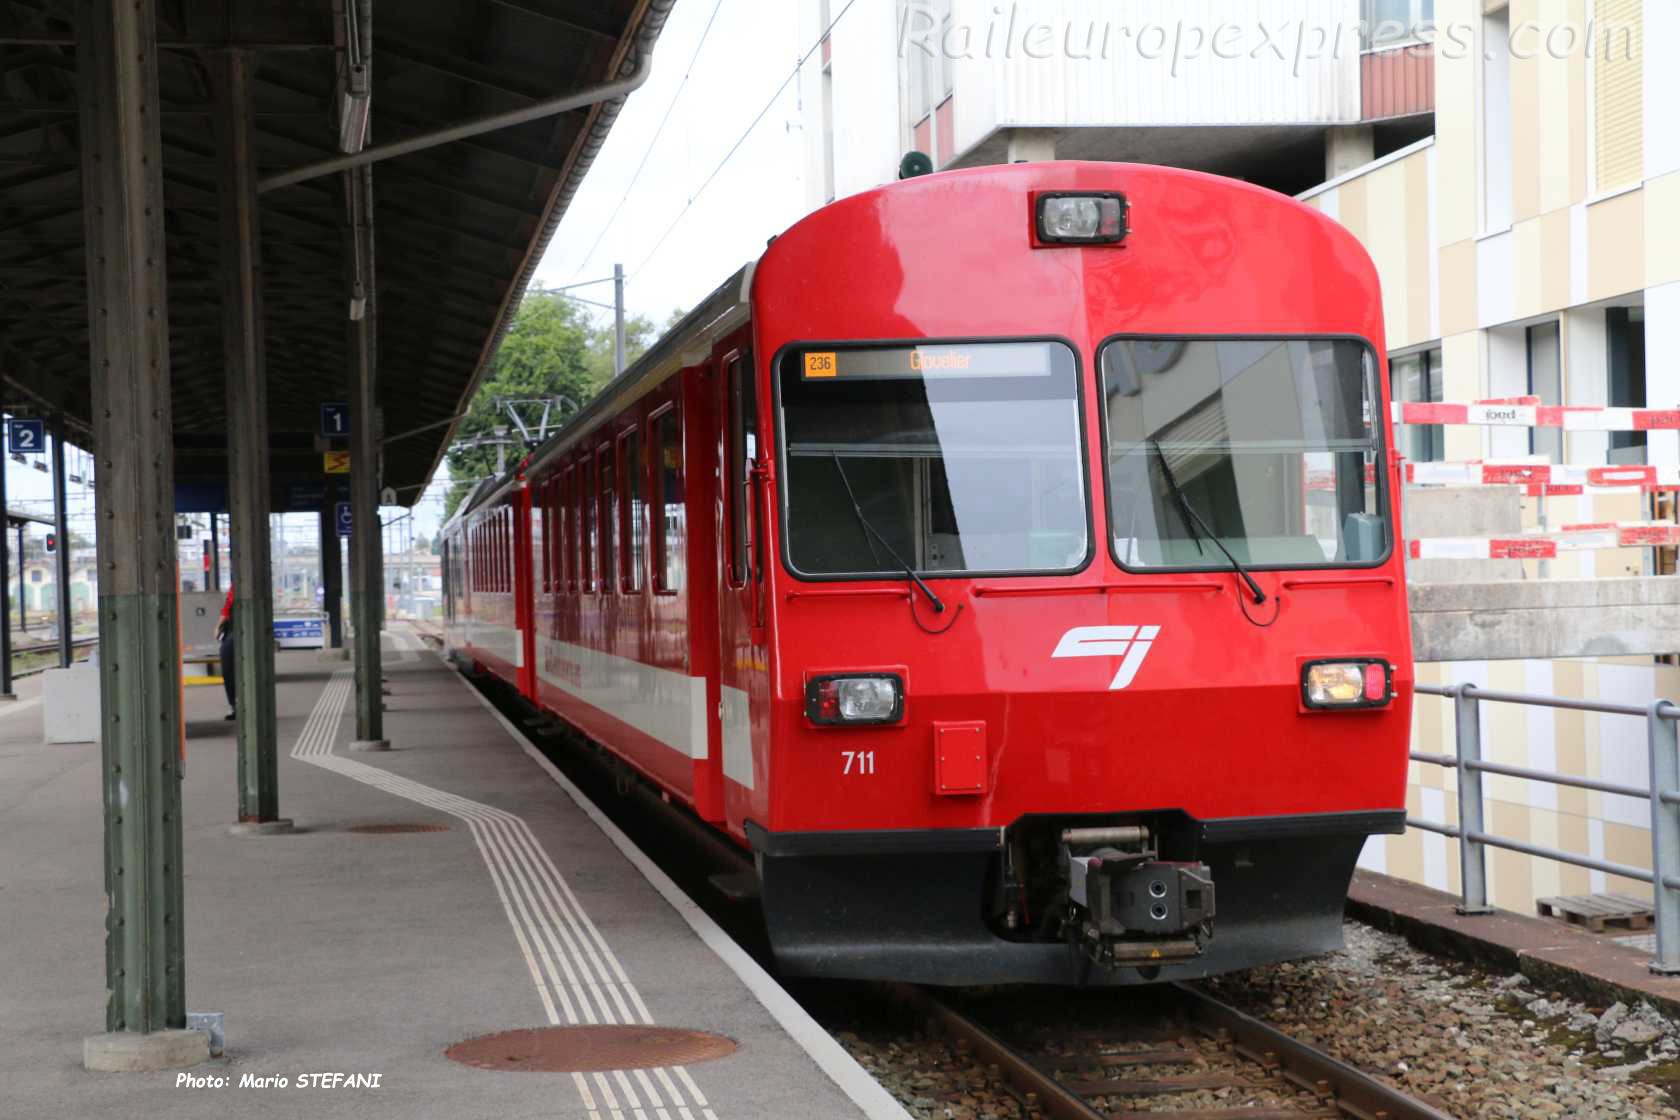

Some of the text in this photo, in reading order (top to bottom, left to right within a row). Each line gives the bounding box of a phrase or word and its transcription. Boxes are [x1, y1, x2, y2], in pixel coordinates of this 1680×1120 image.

[810, 356, 831, 370] 236
[333, 413, 342, 432] 1
[19, 429, 35, 448] 2
[840, 750, 875, 775] 711
